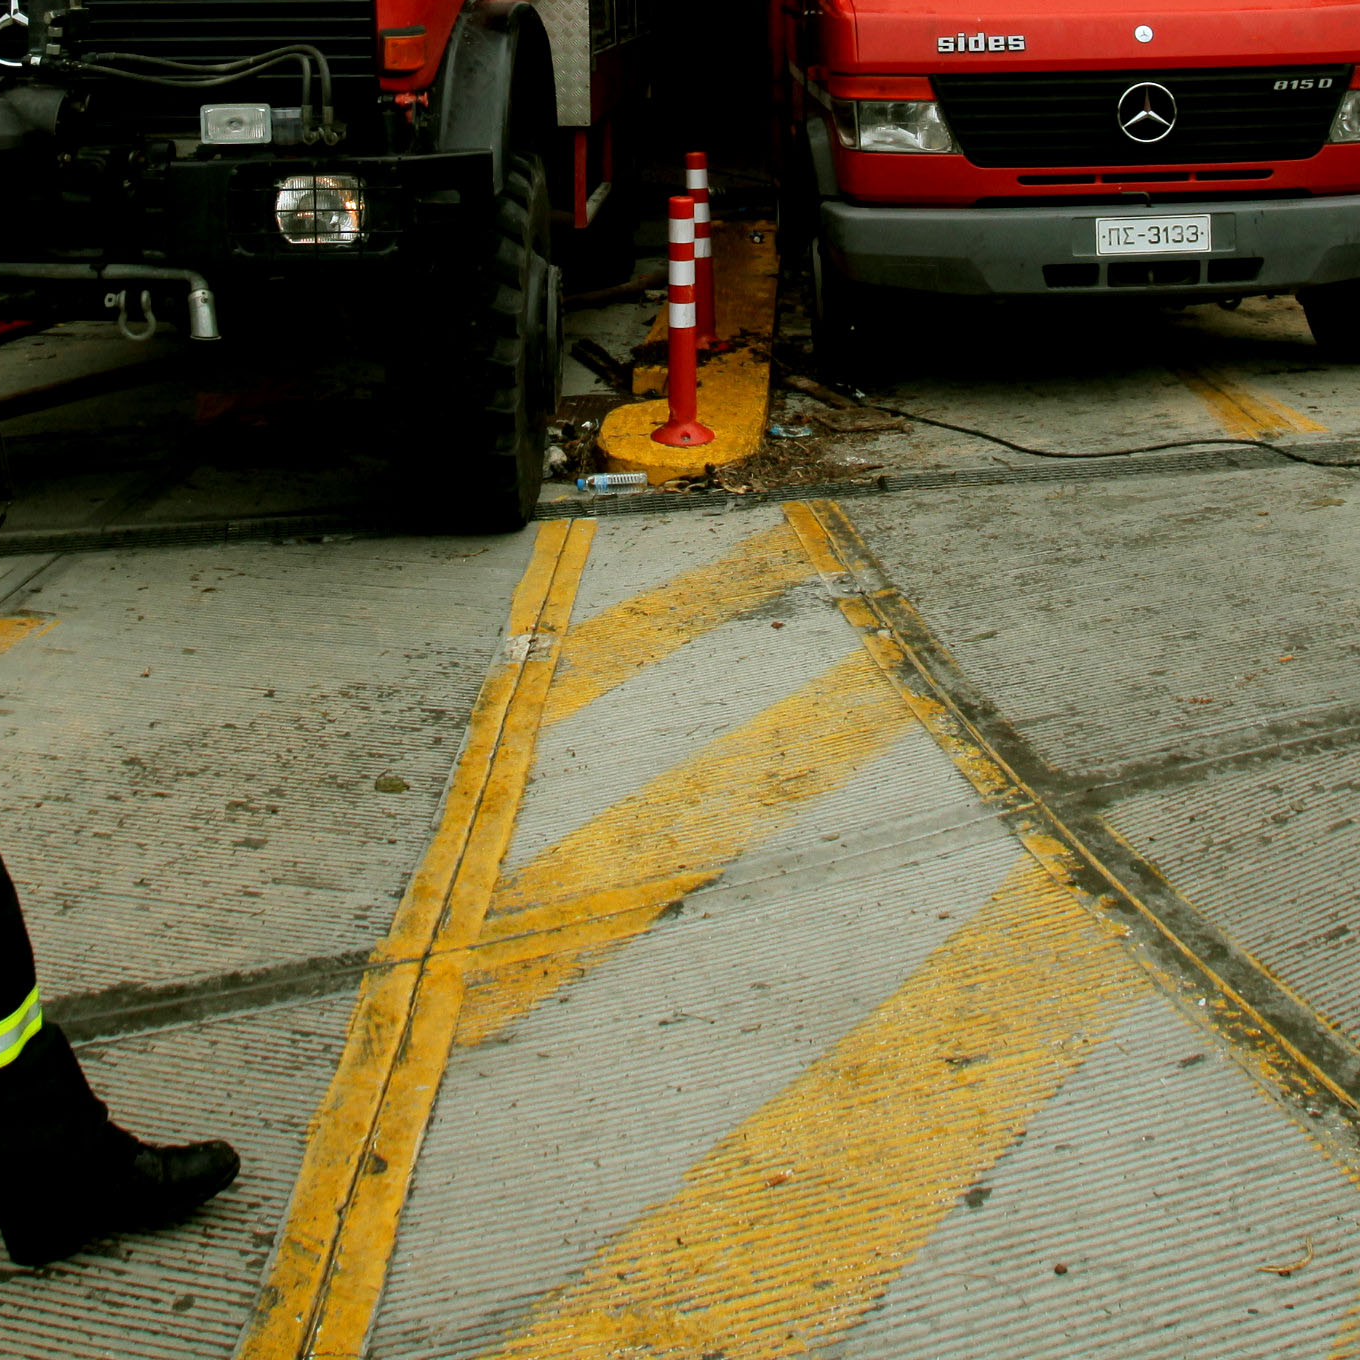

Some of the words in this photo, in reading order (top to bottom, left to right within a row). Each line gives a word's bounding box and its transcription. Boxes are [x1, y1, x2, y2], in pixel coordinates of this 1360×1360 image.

[937, 32, 1026, 52] sides
[1273, 79, 1314, 90] 815
[1318, 78, 1333, 89] D
